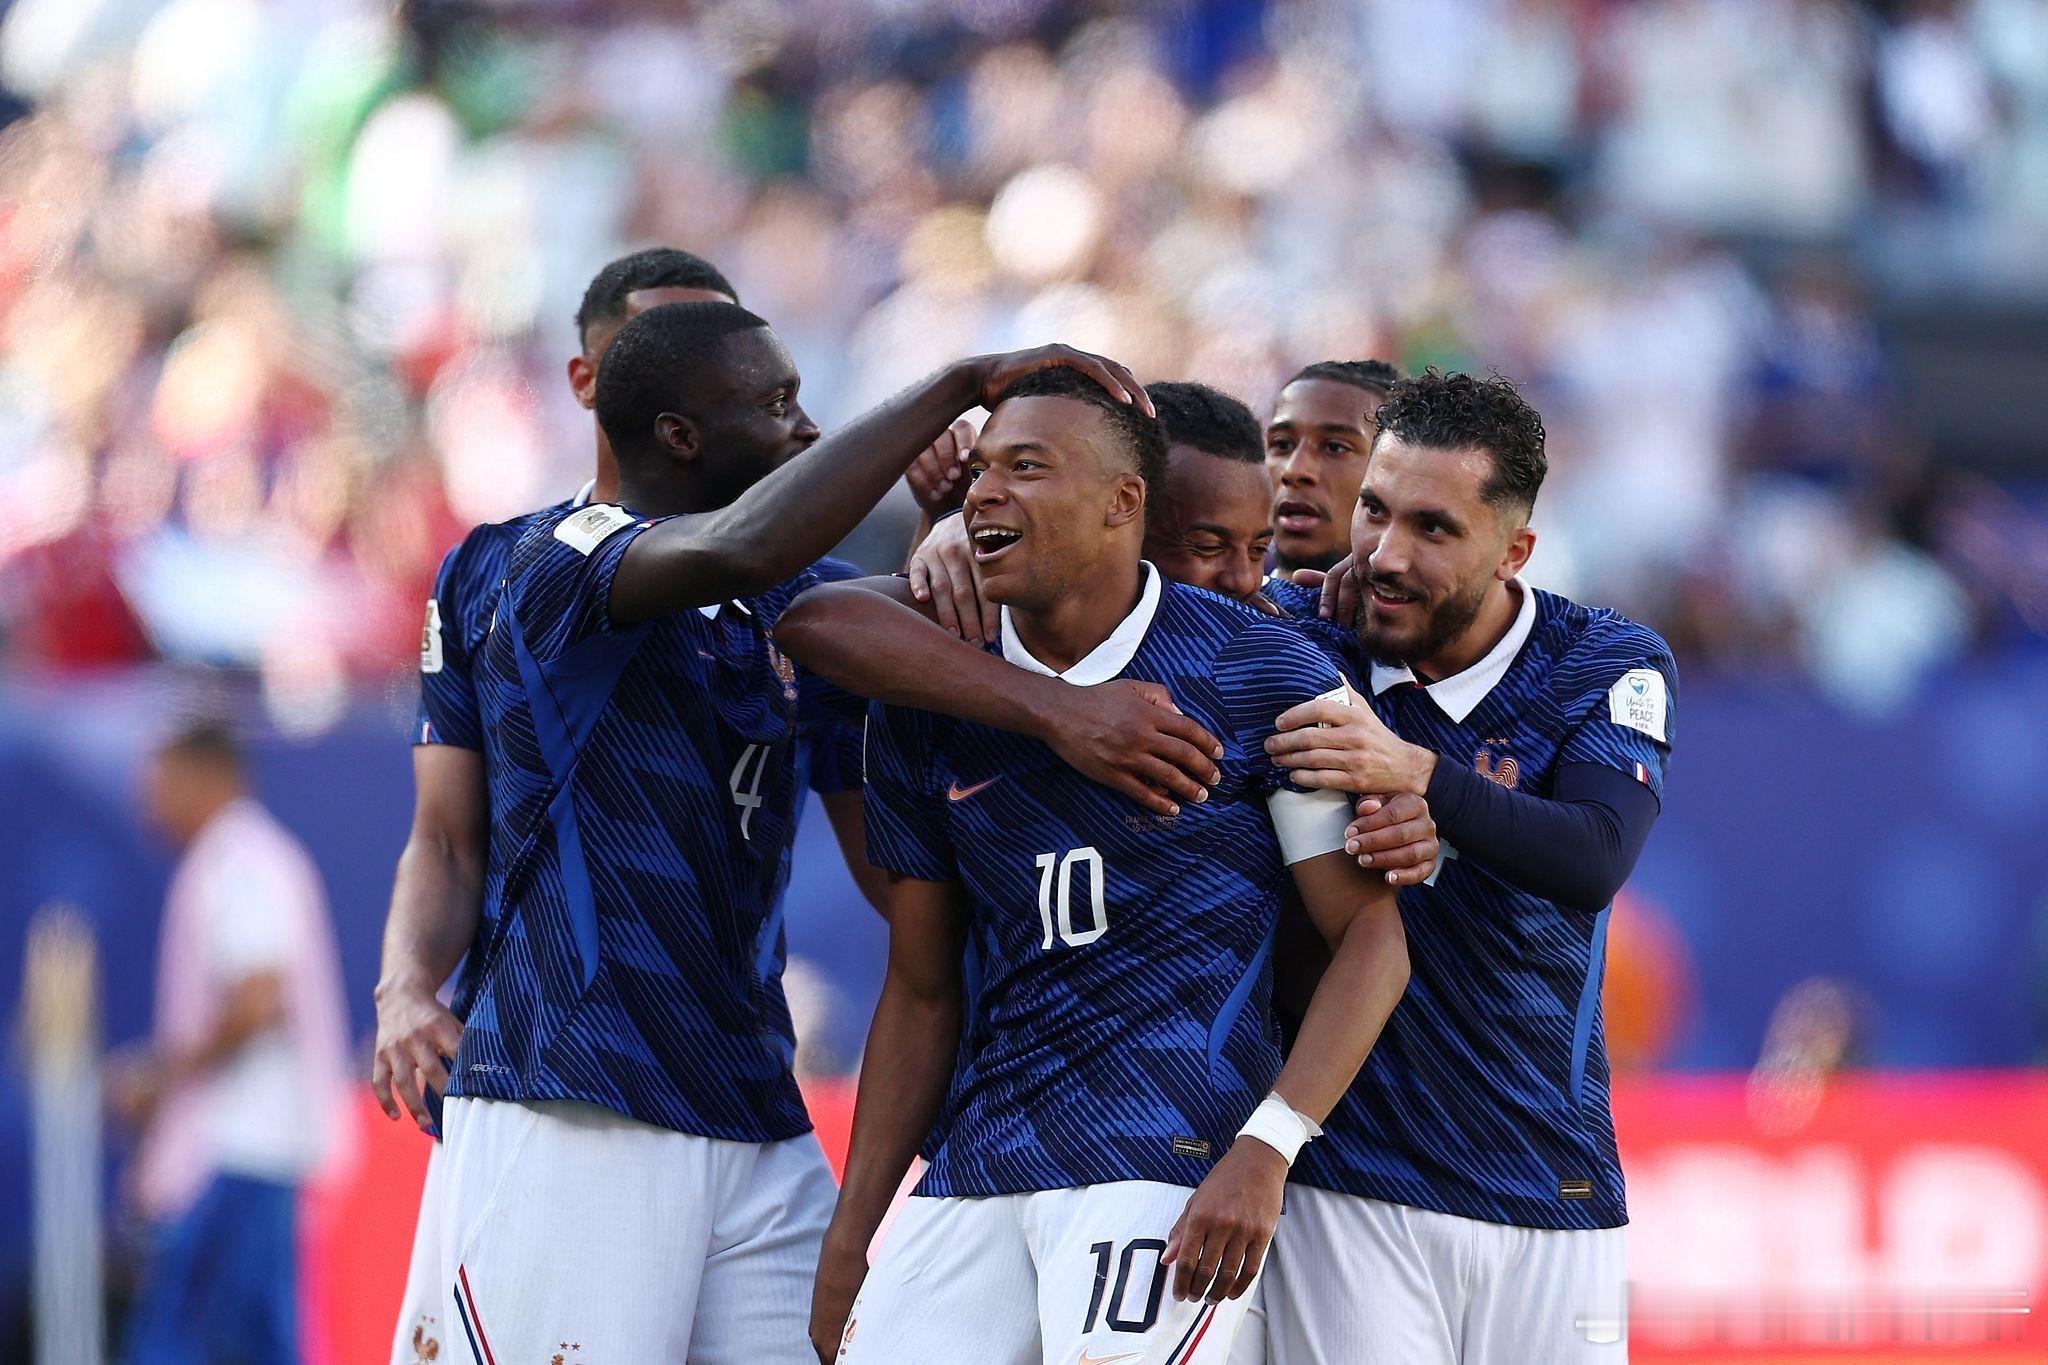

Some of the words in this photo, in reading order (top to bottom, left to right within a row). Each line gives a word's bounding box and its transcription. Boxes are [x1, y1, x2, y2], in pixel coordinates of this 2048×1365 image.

[1629, 708, 1653, 723] PEACE
[729, 744, 771, 840] 4
[1035, 846, 1108, 949] 10
[1082, 1238, 1167, 1334] 10
